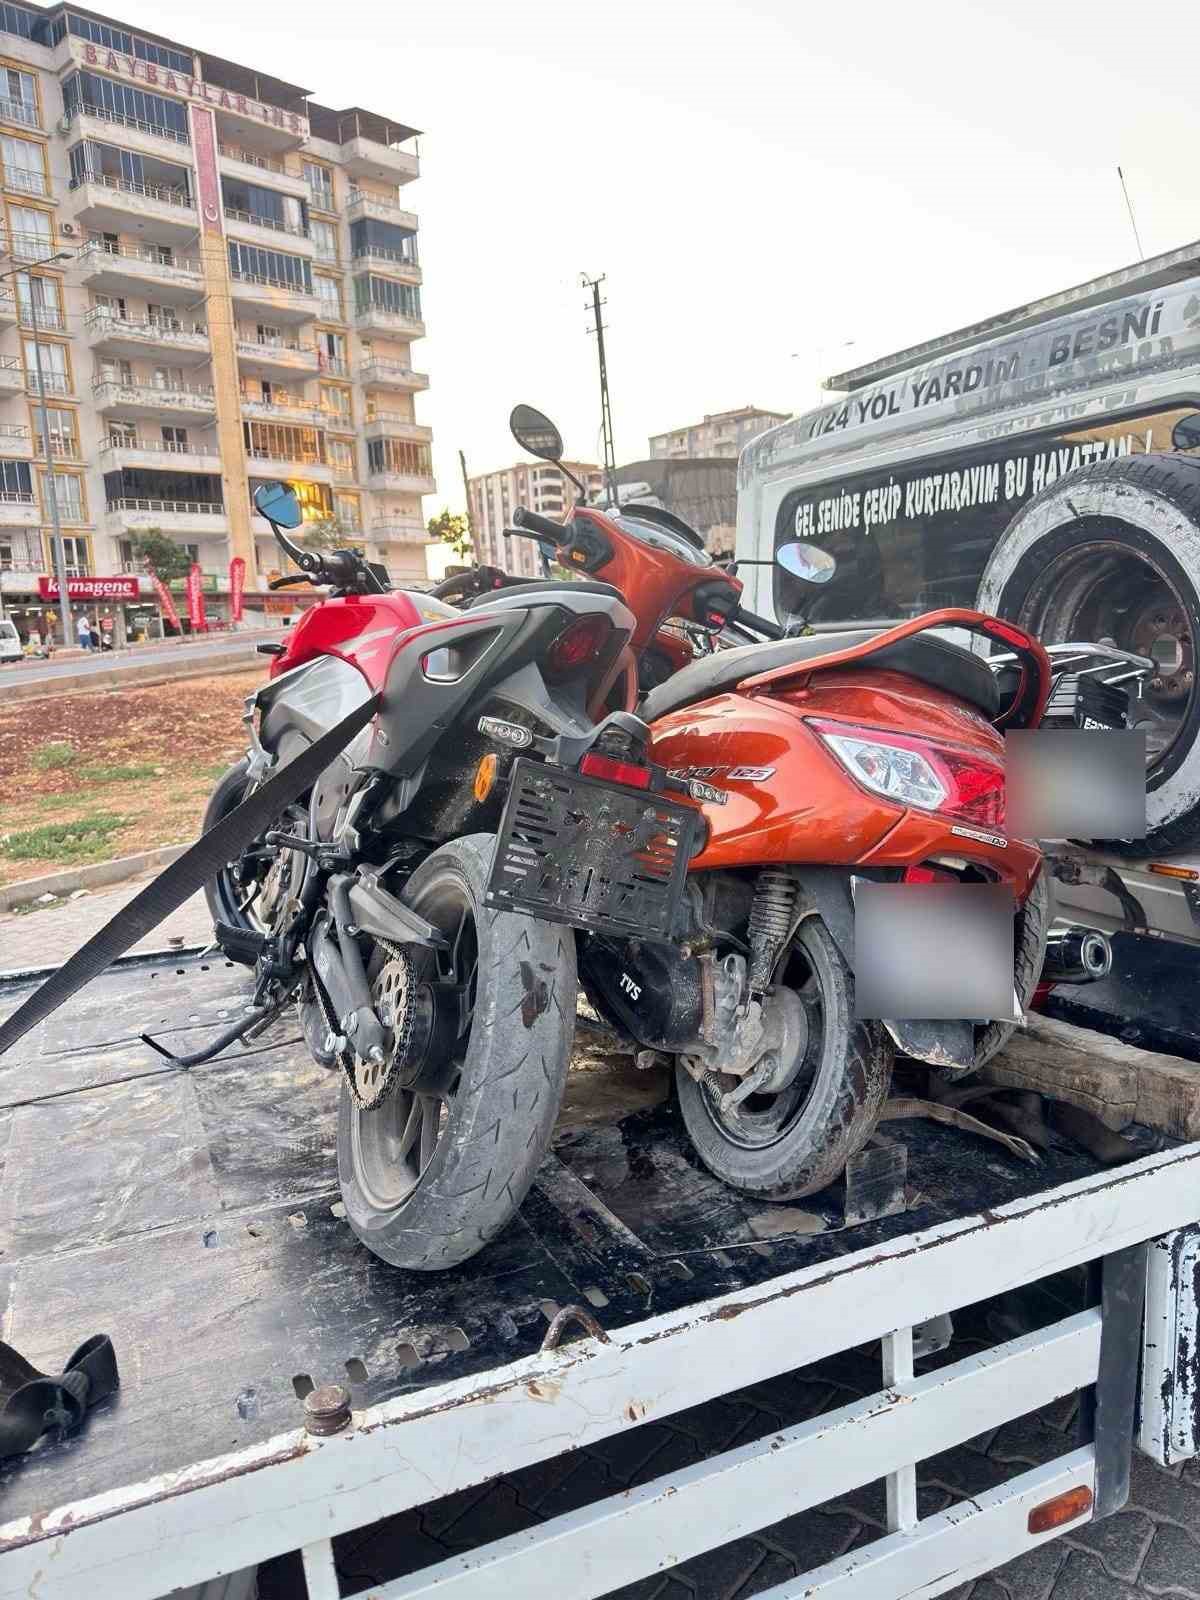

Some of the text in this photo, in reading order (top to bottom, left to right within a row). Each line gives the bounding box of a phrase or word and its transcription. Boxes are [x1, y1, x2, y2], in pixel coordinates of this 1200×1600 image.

[858, 390, 900, 424] YOL
[912, 352, 1020, 408] YARDIM
[795, 503, 815, 537] GEL
[817, 488, 861, 534] SENİDE
[864, 476, 902, 535] ÇEKİP
[1005, 457, 1028, 500] BU
[619, 972, 642, 1001] TVS
